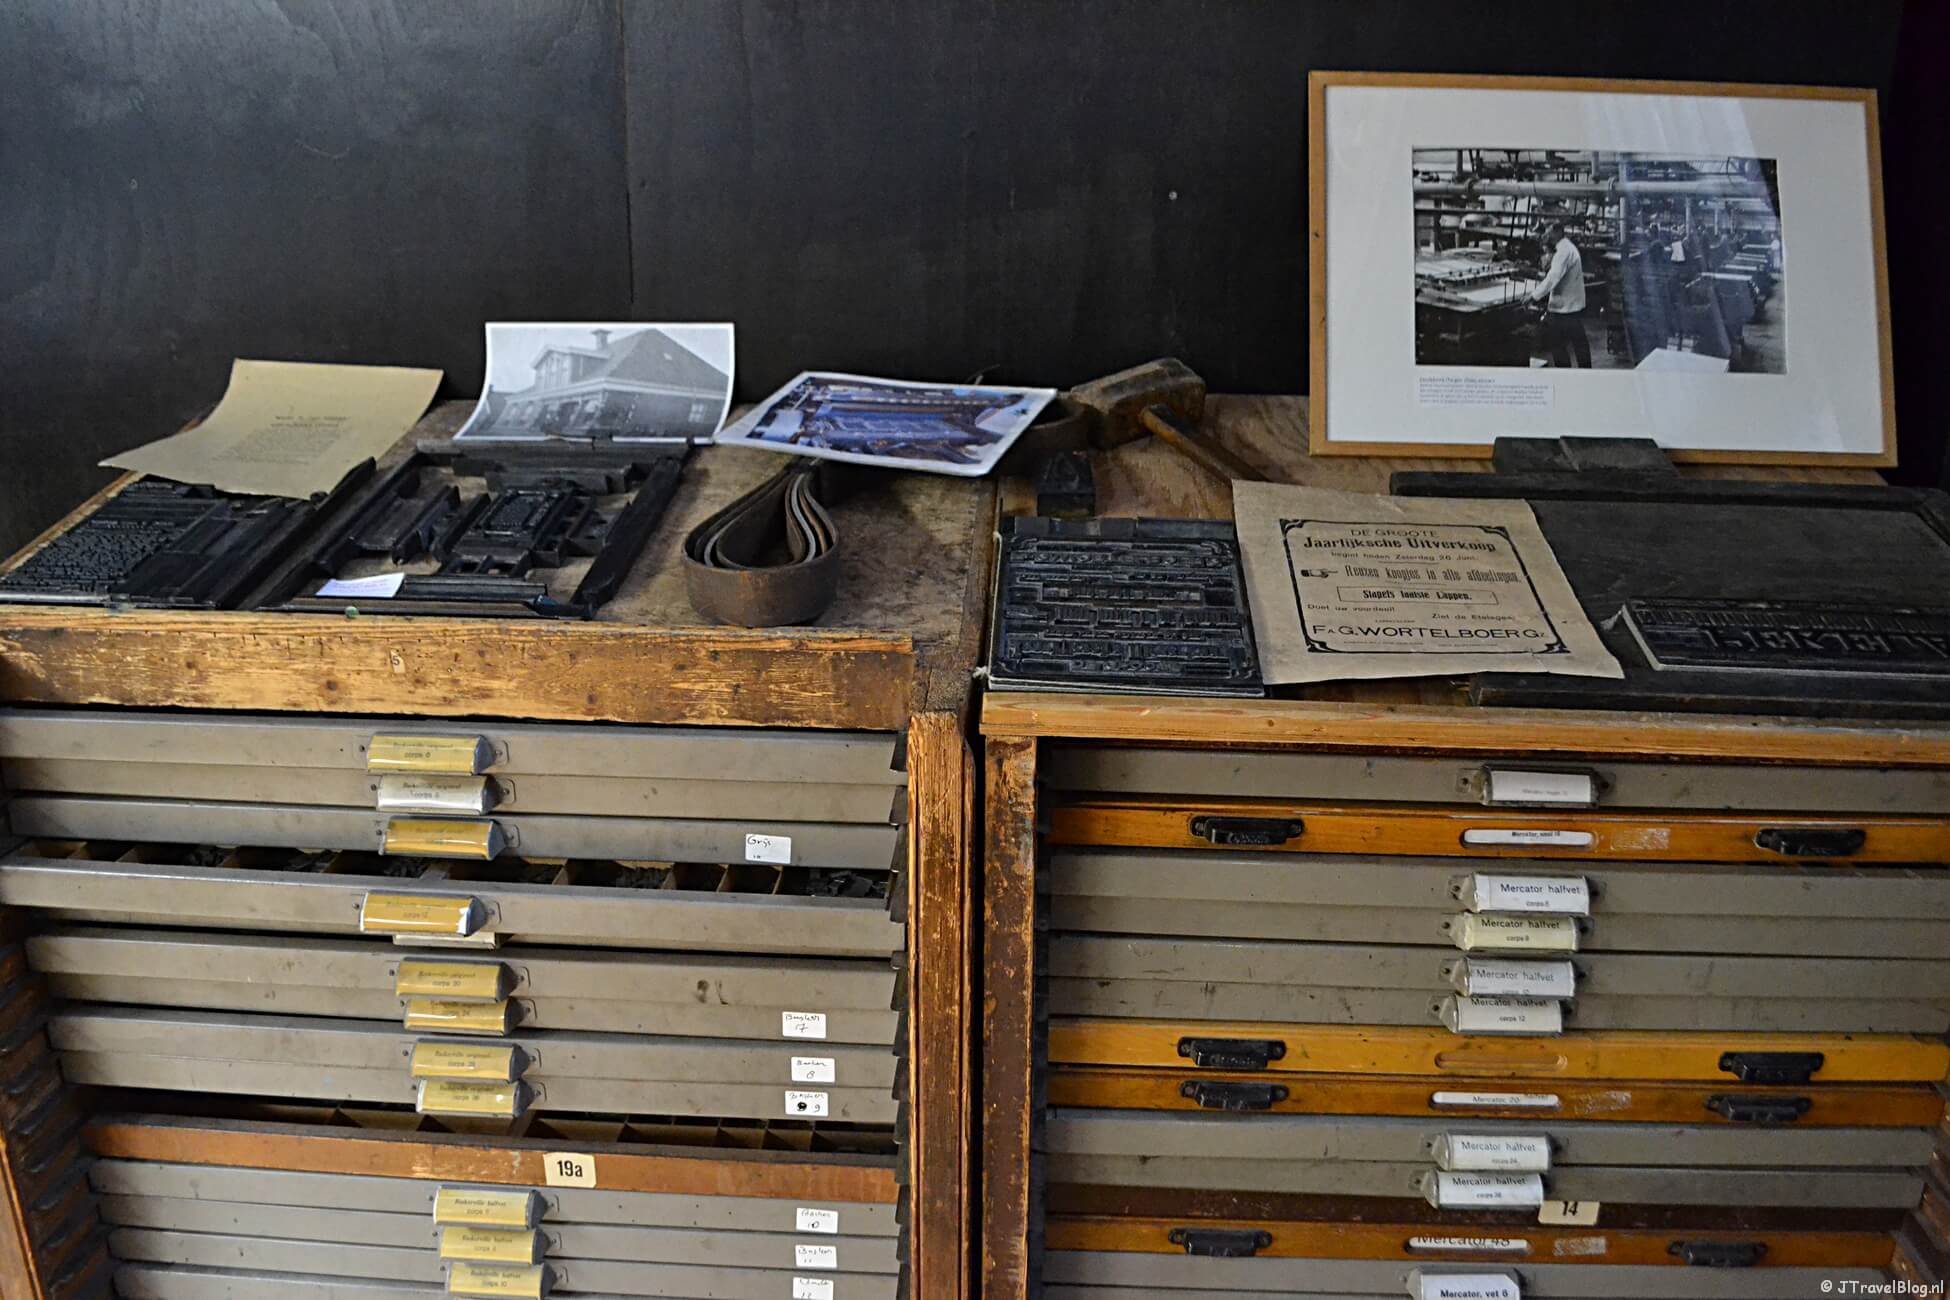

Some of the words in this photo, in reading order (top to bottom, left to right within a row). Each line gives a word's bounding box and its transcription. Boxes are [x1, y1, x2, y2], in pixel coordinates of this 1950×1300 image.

[1351, 528, 1370, 537] DE
[1375, 528, 1438, 538] GROOTE
[1303, 536, 1402, 549] Jaarlijksche
[1406, 537, 1496, 553] Uitverkoop
[392, 655, 401, 667] 5
[1500, 883, 1543, 894] Mercator
[1548, 884, 1582, 895] halfvet
[1480, 918, 1524, 929] Mercator
[1528, 919, 1561, 930] halfvet
[1476, 968, 1519, 980] Mercator
[1522, 970, 1555, 982] halfvet
[1471, 998, 1513, 1008] Mercator
[1516, 999, 1548, 1009] halfvet
[1460, 1140, 1501, 1152] Mercator
[1505, 1141, 1536, 1152] halfvet
[556, 1159, 583, 1178] 19a
[1452, 1176, 1491, 1187] Mercator
[1495, 1177, 1527, 1186] halfvet
[1562, 1200, 1579, 1217] 14
[1485, 1290, 1499, 1298] vet
